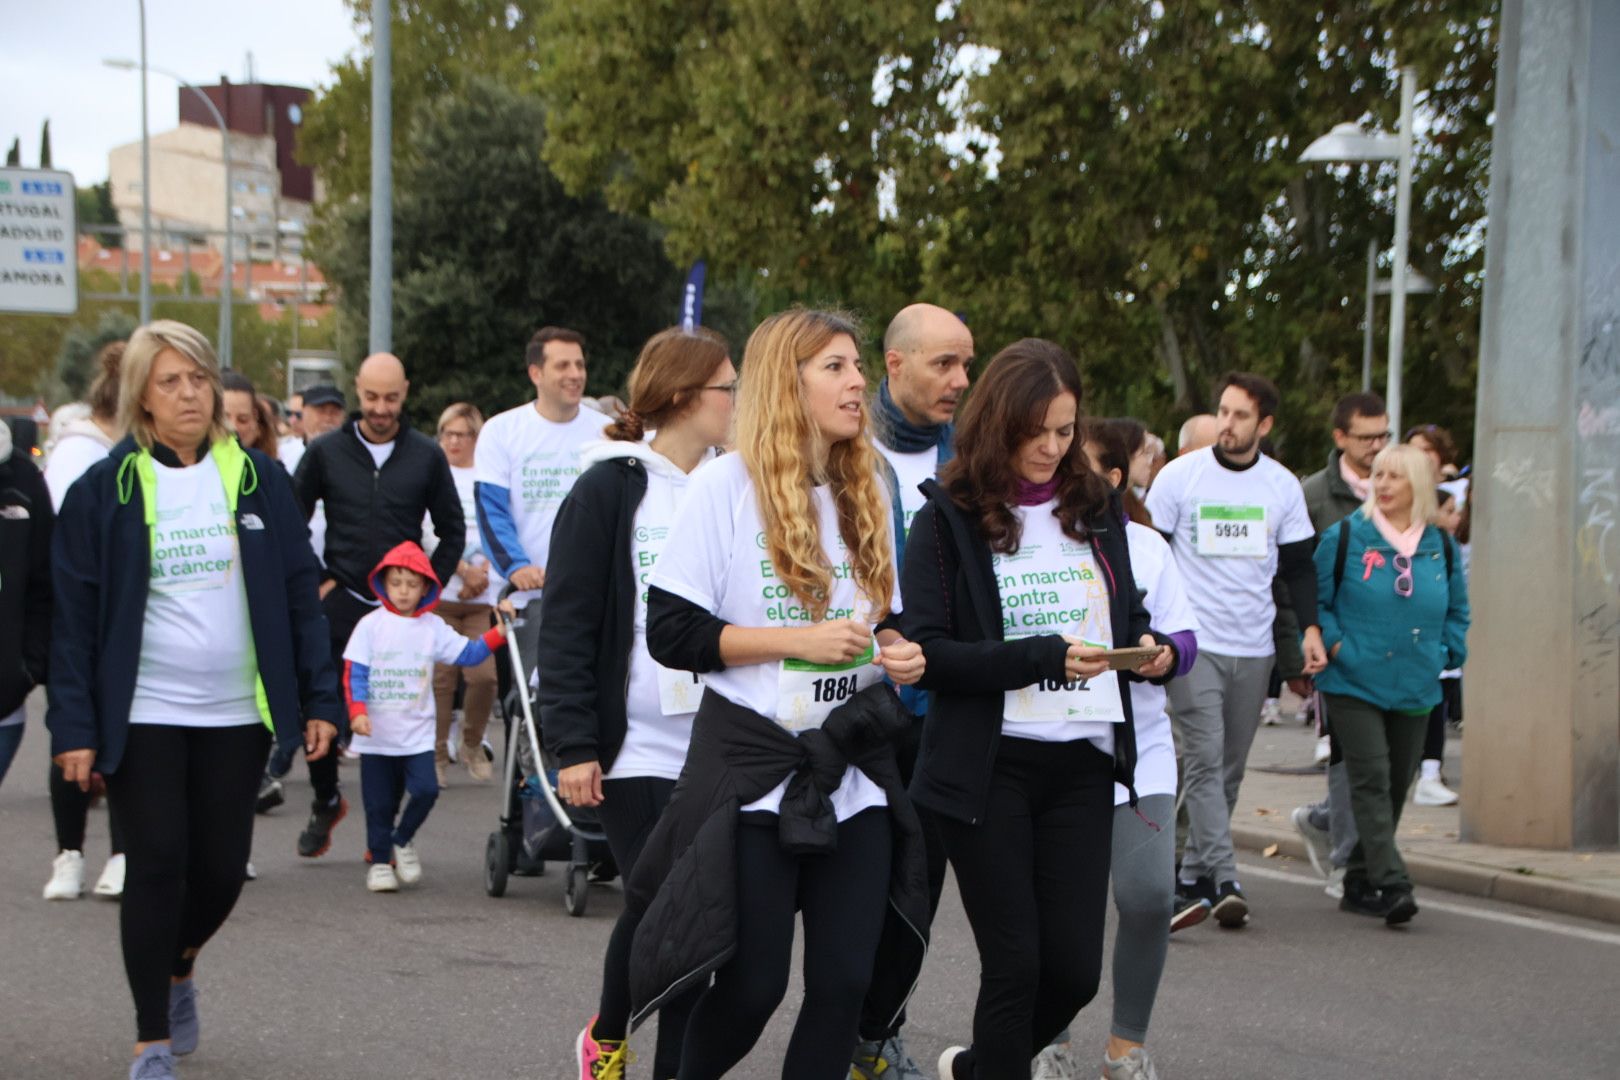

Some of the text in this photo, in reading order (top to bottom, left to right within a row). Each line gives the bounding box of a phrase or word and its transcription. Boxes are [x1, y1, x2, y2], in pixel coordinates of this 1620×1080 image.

[0, 270, 64, 286] AMORA
[1215, 523, 1248, 537] 5934
[169, 559, 232, 576] cáncer
[1021, 566, 1095, 586] marcha
[1021, 607, 1088, 627] cáncer
[811, 673, 858, 703] 1884
